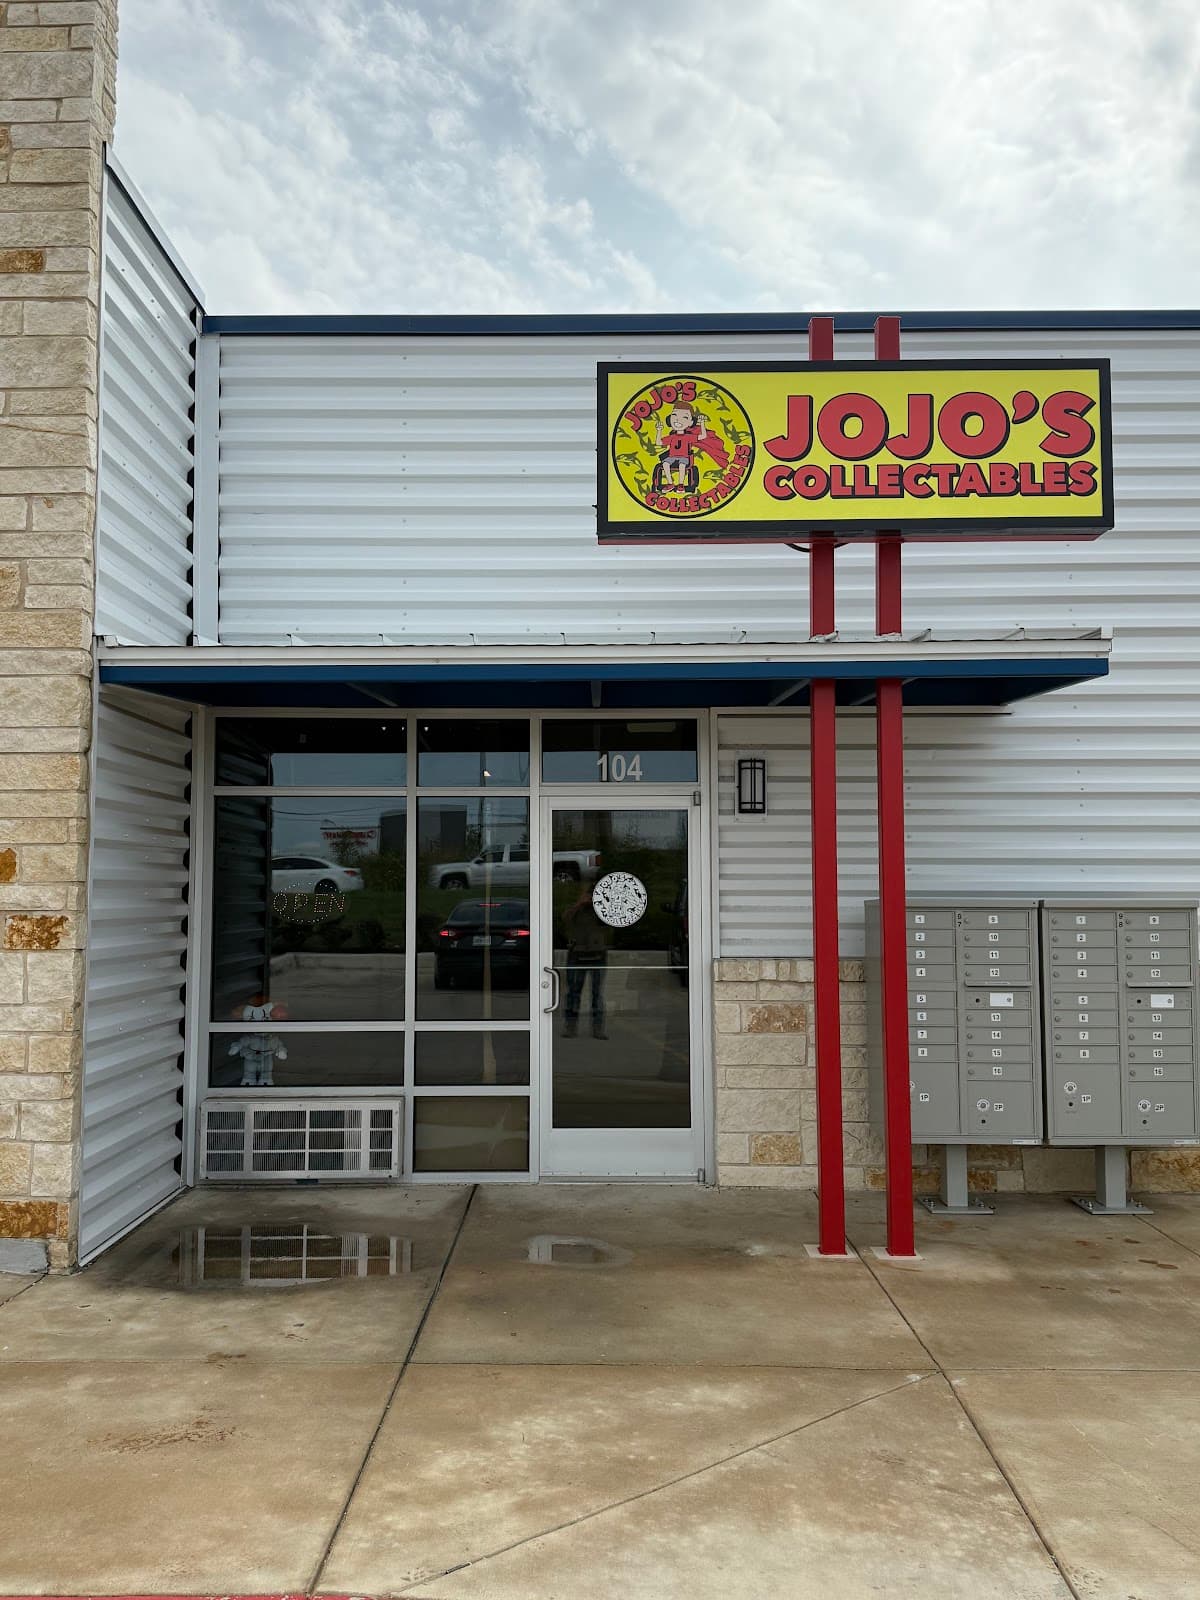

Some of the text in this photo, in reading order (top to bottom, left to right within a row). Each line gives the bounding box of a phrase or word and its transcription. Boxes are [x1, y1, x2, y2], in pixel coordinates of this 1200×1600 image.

[625, 381, 697, 432] JOJO'S
[763, 390, 1096, 461] JOJO'S
[674, 439, 682, 450] J
[645, 444, 752, 512] COLLECTABLES
[763, 461, 1098, 499] COLLECTABLES
[596, 753, 643, 782] 104
[273, 893, 345, 913] OPEN
